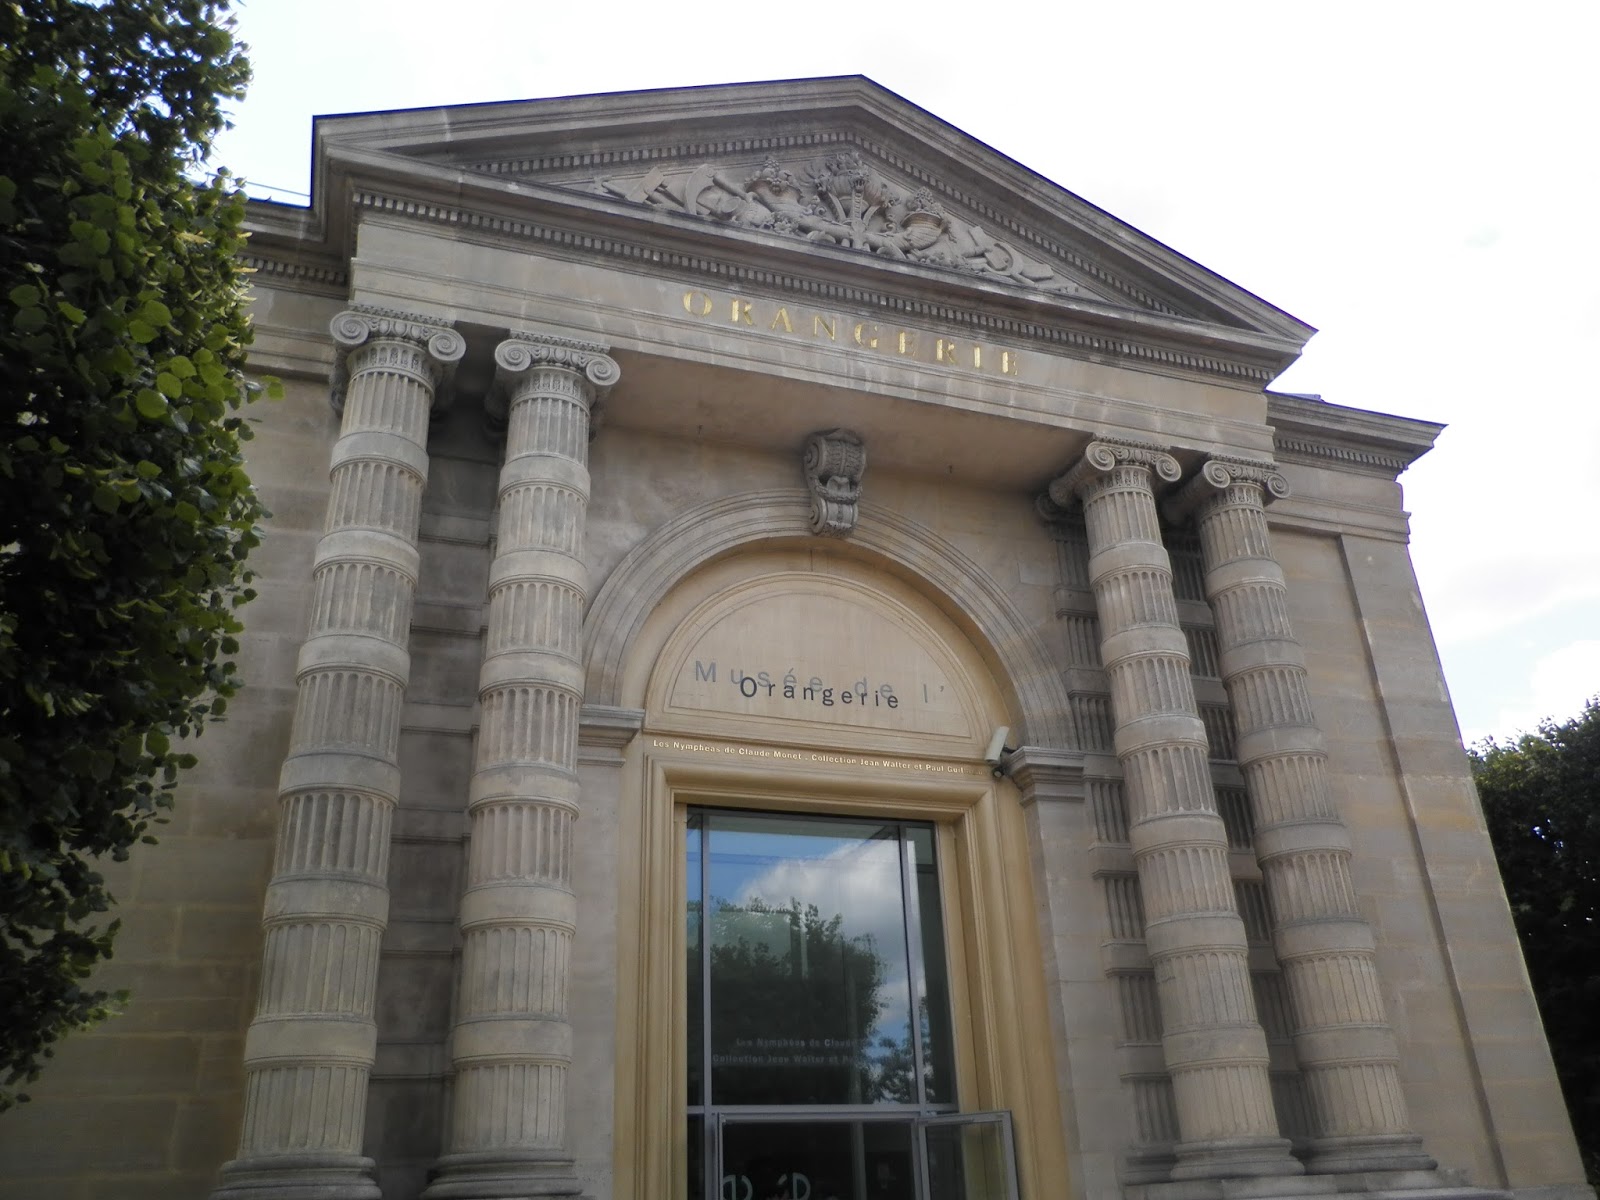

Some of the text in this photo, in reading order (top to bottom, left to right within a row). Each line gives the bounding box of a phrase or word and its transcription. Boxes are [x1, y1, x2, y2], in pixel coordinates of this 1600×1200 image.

[682, 289, 1019, 376] ORANGERIE
[694, 660, 824, 693] Musée
[854, 676, 894, 700] de
[739, 676, 899, 709] Orangerie
[653, 739, 670, 748] Les
[724, 746, 735, 754] de
[738, 747, 770, 758] Claude
[773, 750, 802, 760] Monet
[811, 753, 857, 765] Collection
[860, 758, 880, 767] Jean
[882, 759, 911, 769] Walter
[925, 763, 944, 772] Paul
